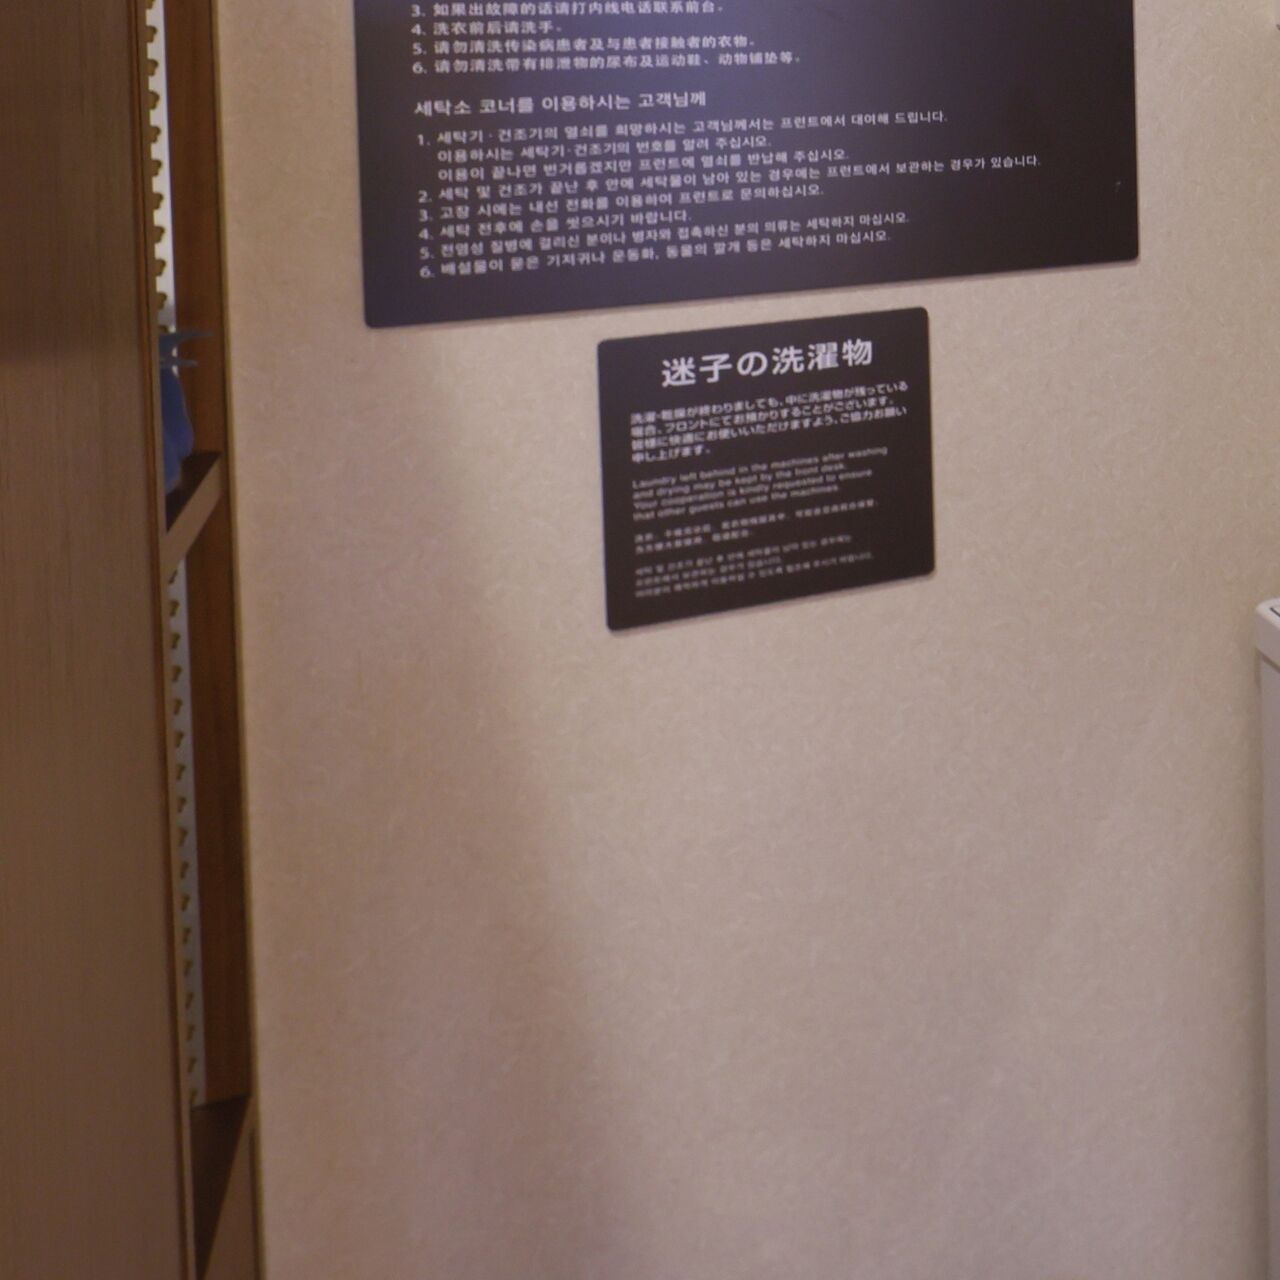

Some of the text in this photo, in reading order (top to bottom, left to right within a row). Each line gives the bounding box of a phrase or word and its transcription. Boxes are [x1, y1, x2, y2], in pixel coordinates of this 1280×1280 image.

[414, 91, 707, 117] 세탁소 코너를 이용하시는 고객님께
[661, 338, 873, 387] 迷子の洗濯物
